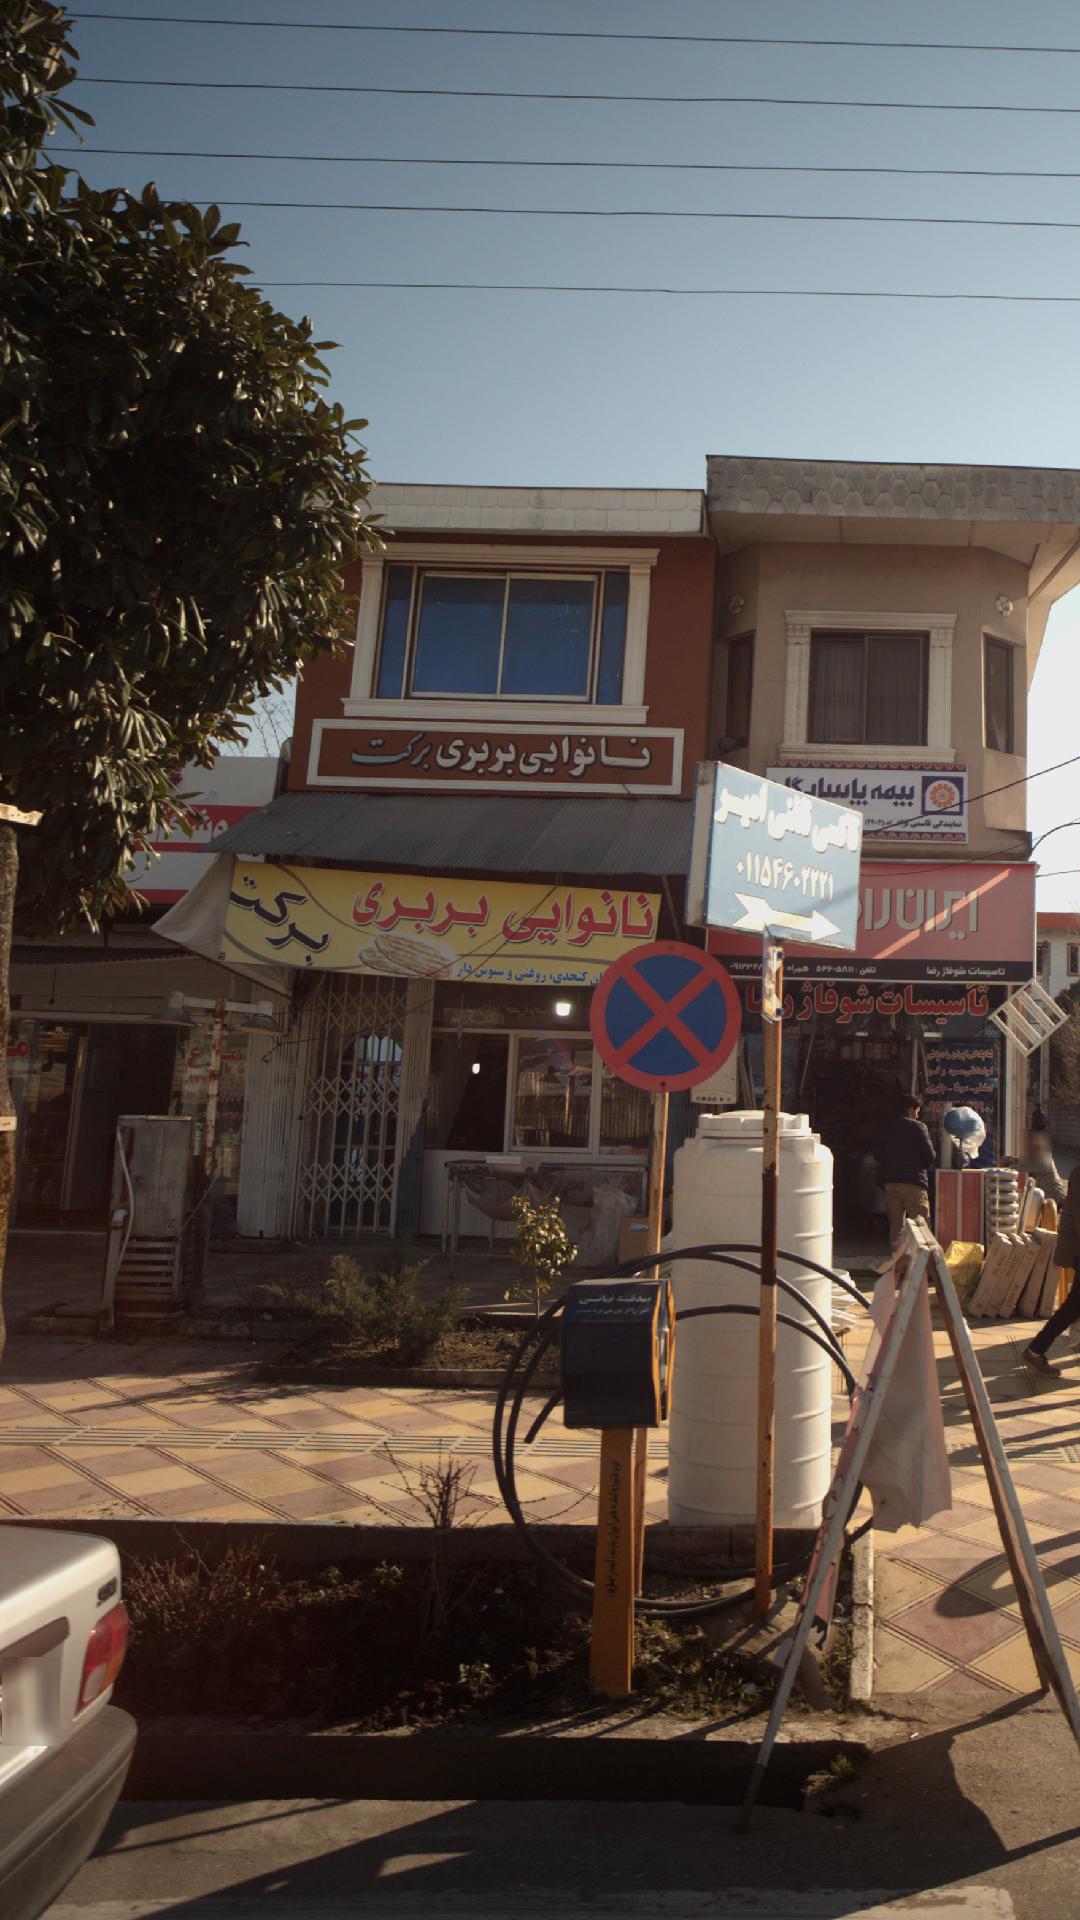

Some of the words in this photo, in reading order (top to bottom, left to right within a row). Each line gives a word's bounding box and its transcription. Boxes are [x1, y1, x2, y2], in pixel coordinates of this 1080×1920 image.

[351, 731, 432, 770] برکت
[434, 735, 518, 776] بربری
[518, 735, 652, 777] نانوایی
[870, 784, 915, 807] بیمه
[230, 874, 330, 967] برکت
[351, 880, 491, 937] بربری
[501, 890, 656, 946] نانوایی
[896, 887, 979, 941] ایران
[795, 980, 875, 1023] شوفاژ
